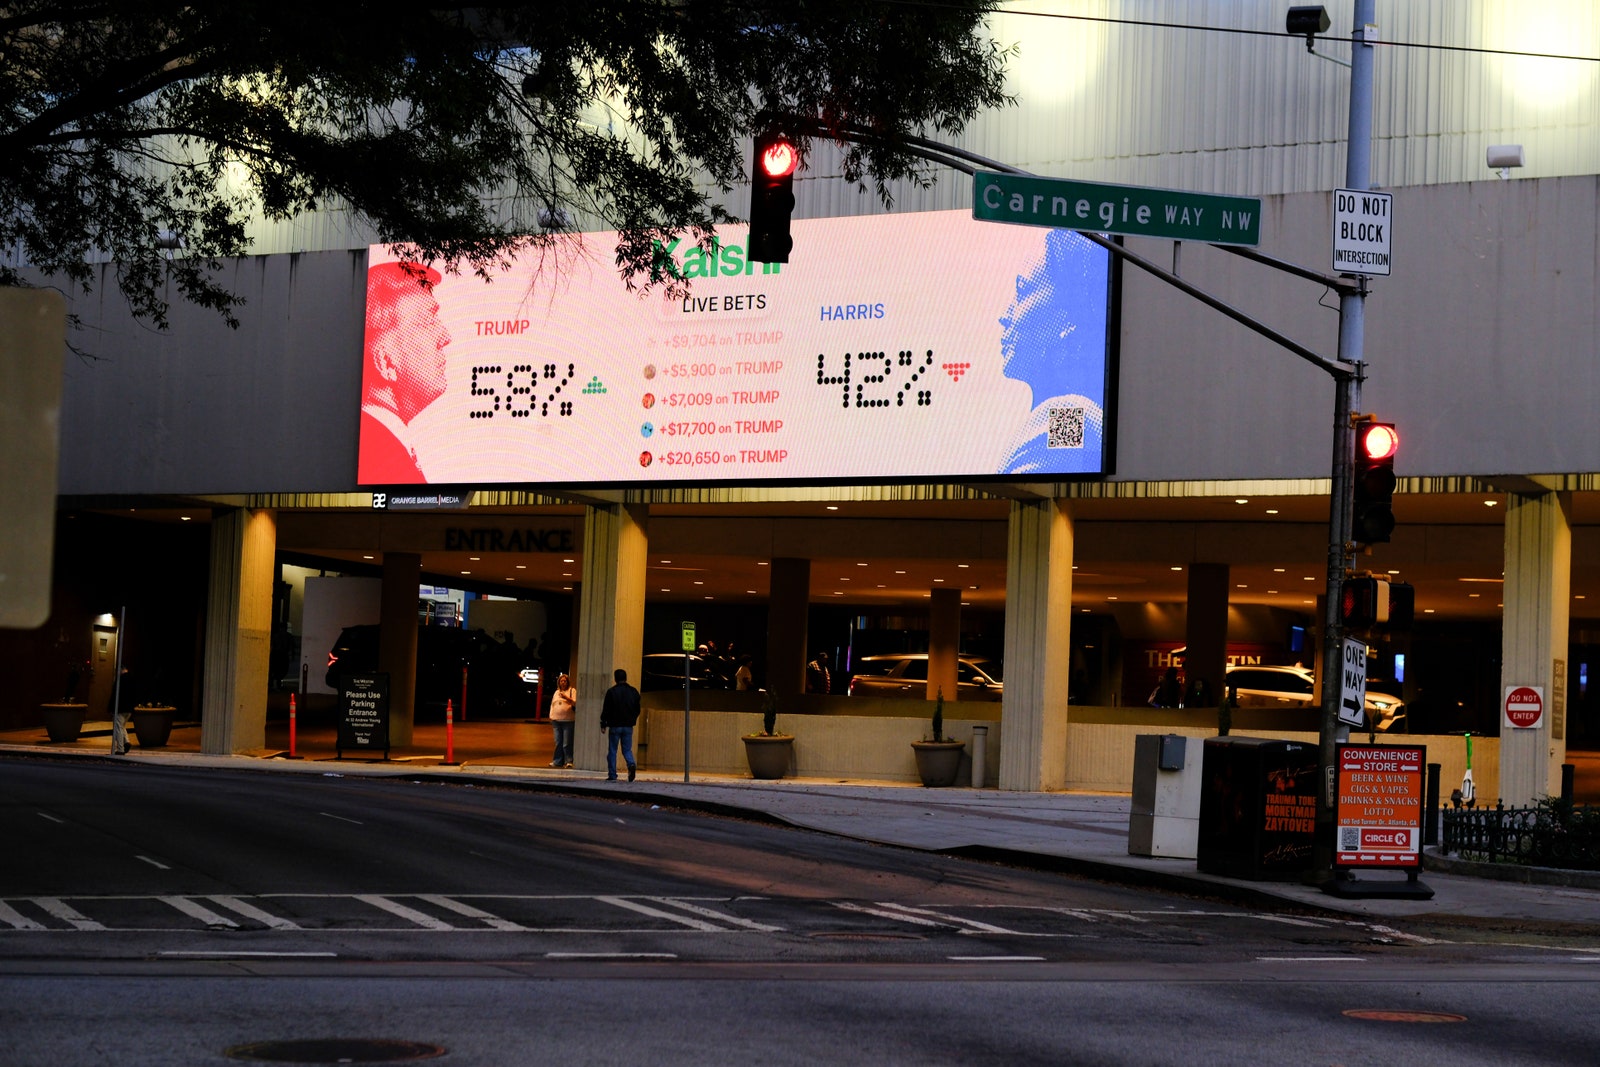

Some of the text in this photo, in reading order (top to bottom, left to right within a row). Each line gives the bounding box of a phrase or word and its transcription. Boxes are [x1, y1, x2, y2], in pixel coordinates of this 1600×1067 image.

[983, 183, 1252, 231] Carnegie WAY NW
[1338, 194, 1388, 217] DO NOT
[1341, 221, 1383, 243] BLOCK
[1335, 249, 1389, 266] INTERSECTION
[682, 294, 767, 313] LIVE BETS
[820, 303, 885, 321] HARRIS
[474, 319, 530, 336] TRUMP
[663, 330, 784, 348] +$9,704 on TRUMP
[662, 360, 783, 378] +$5,900 on TRUMP
[817, 349, 933, 409] 42%
[470, 363, 574, 419] 58%
[661, 391, 780, 407] +$7,009 on TRUMP
[660, 420, 783, 437] +$17,700 on TRUMP
[658, 449, 788, 467] +$20,650 on TRUMP
[391, 496, 459, 504] ORANGE BARREL MEDIA
[445, 528, 572, 552] ENTRANCE
[1143, 649, 1182, 668] THE
[1345, 645, 1364, 668] ONE
[1345, 669, 1364, 692] WAY
[368, 691, 381, 699] Use
[1510, 694, 1537, 702] DO NOT
[351, 700, 375, 709] Parking
[1512, 712, 1534, 720] ENTER
[1343, 750, 1418, 761] CONVENIENCE
[1363, 762, 1398, 772] STORE
[1351, 773, 1409, 783] BEER & WINE
[1350, 784, 1409, 794] CIGS & VAPES
[1266, 793, 1297, 805] TRAUMA
[1341, 796, 1418, 806] DRINKS & SNACKS
[1265, 805, 1316, 819] MONEYMAN
[1364, 807, 1394, 816] LOTTO
[1264, 817, 1315, 833] ZAYTOVEN
[1364, 834, 1394, 843] CIRCLE
